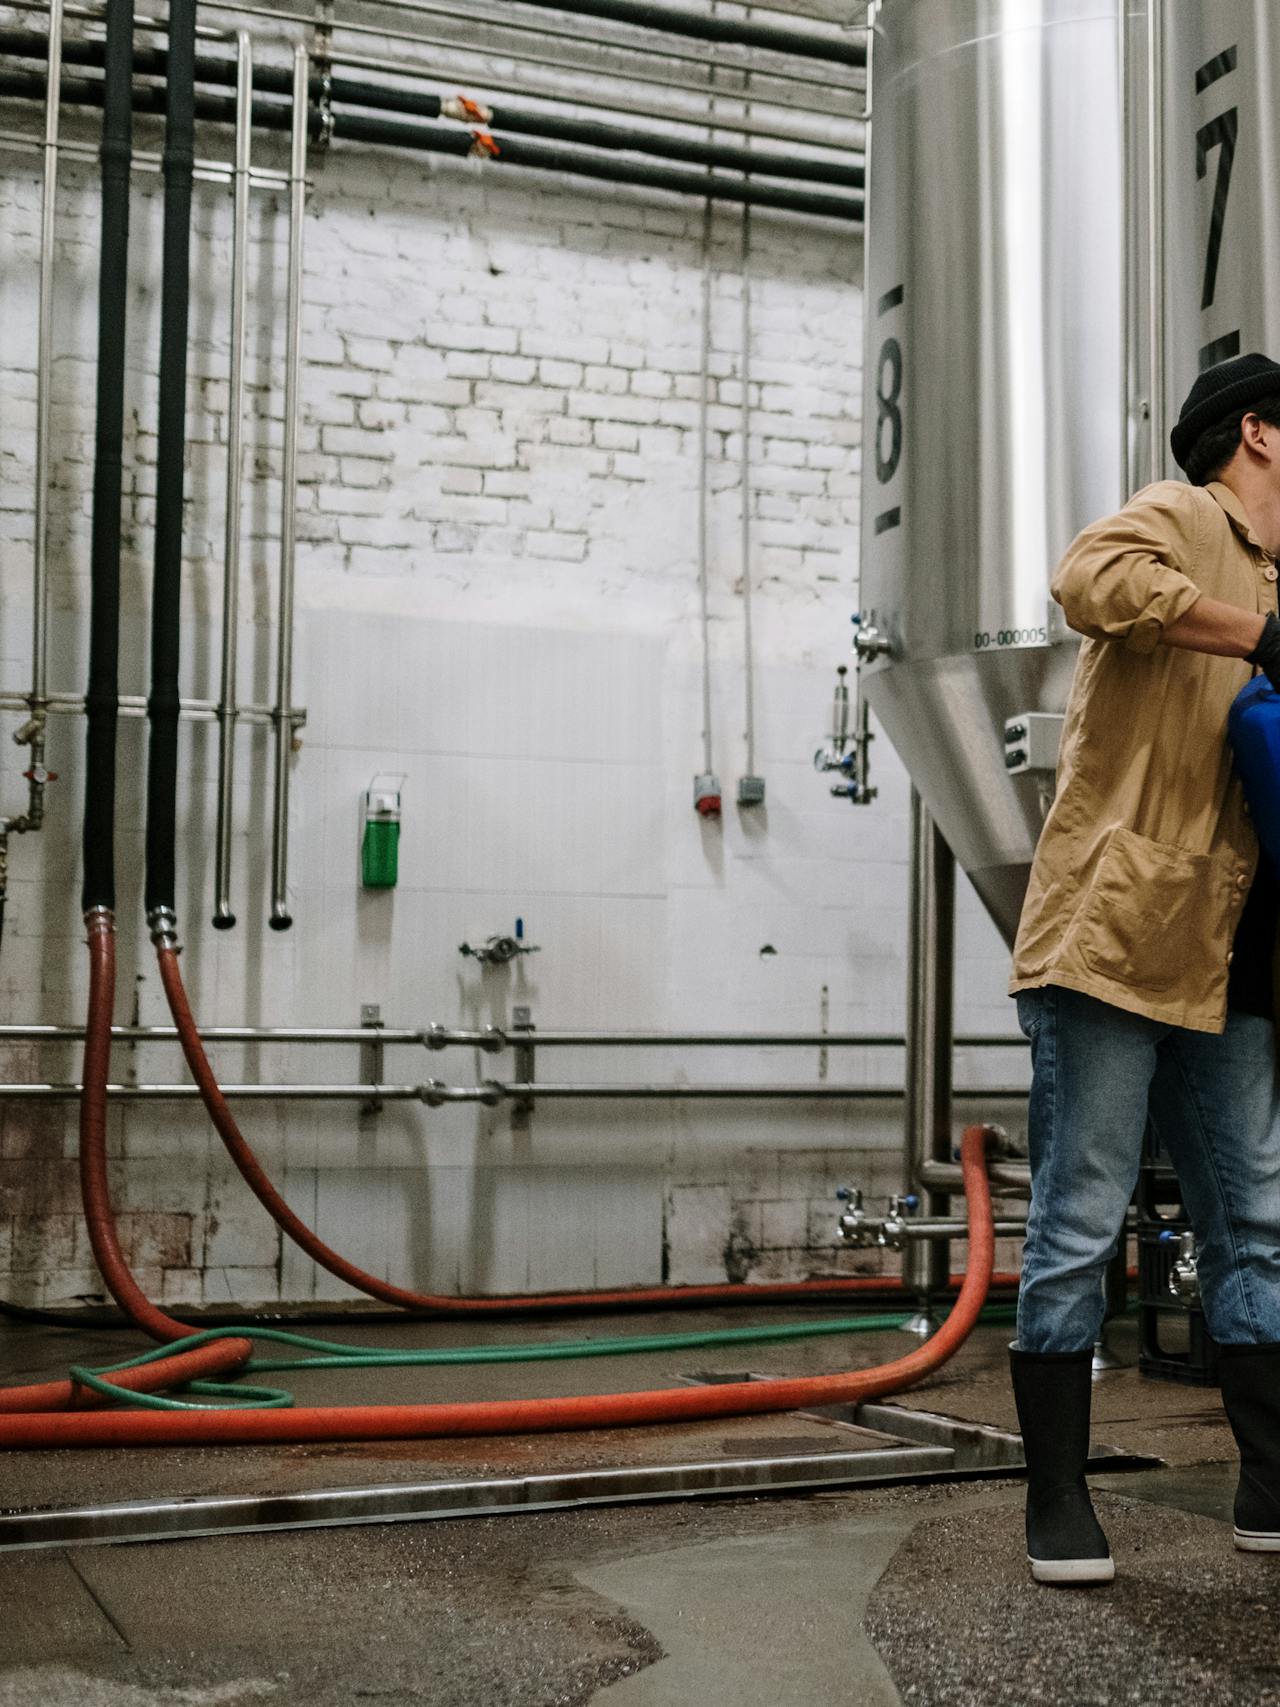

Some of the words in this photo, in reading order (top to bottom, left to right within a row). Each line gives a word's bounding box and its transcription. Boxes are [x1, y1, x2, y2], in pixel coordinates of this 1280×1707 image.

[1195, 106, 1238, 311] 7
[875, 337, 902, 485] 8
[974, 627, 1047, 649] 00-000005
